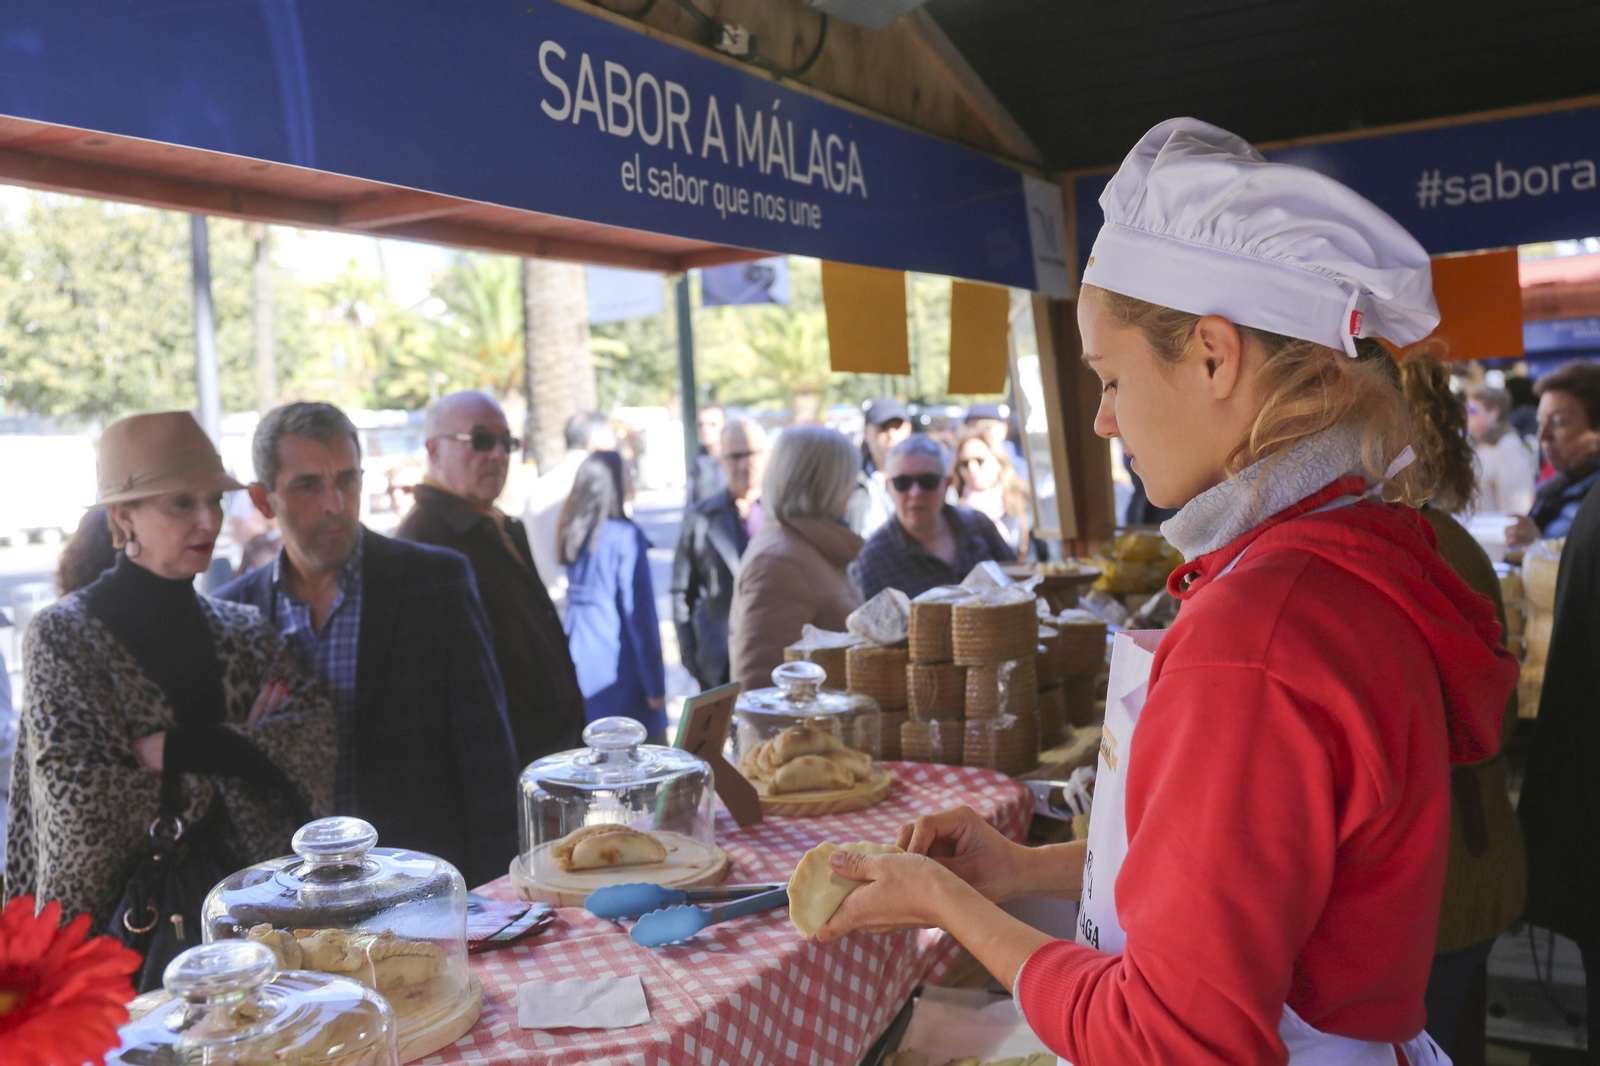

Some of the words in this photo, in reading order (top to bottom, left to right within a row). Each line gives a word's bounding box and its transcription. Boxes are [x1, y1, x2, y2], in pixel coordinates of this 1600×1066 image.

[538, 39, 693, 155] SABOR
[701, 94, 728, 165] A
[734, 98, 867, 198] MÁLAGA
[620, 152, 643, 194] el
[647, 162, 708, 206] sabor
[713, 182, 749, 220] que
[753, 193, 786, 224] nos
[789, 200, 822, 230] une
[1416, 159, 1597, 208] #sabora
